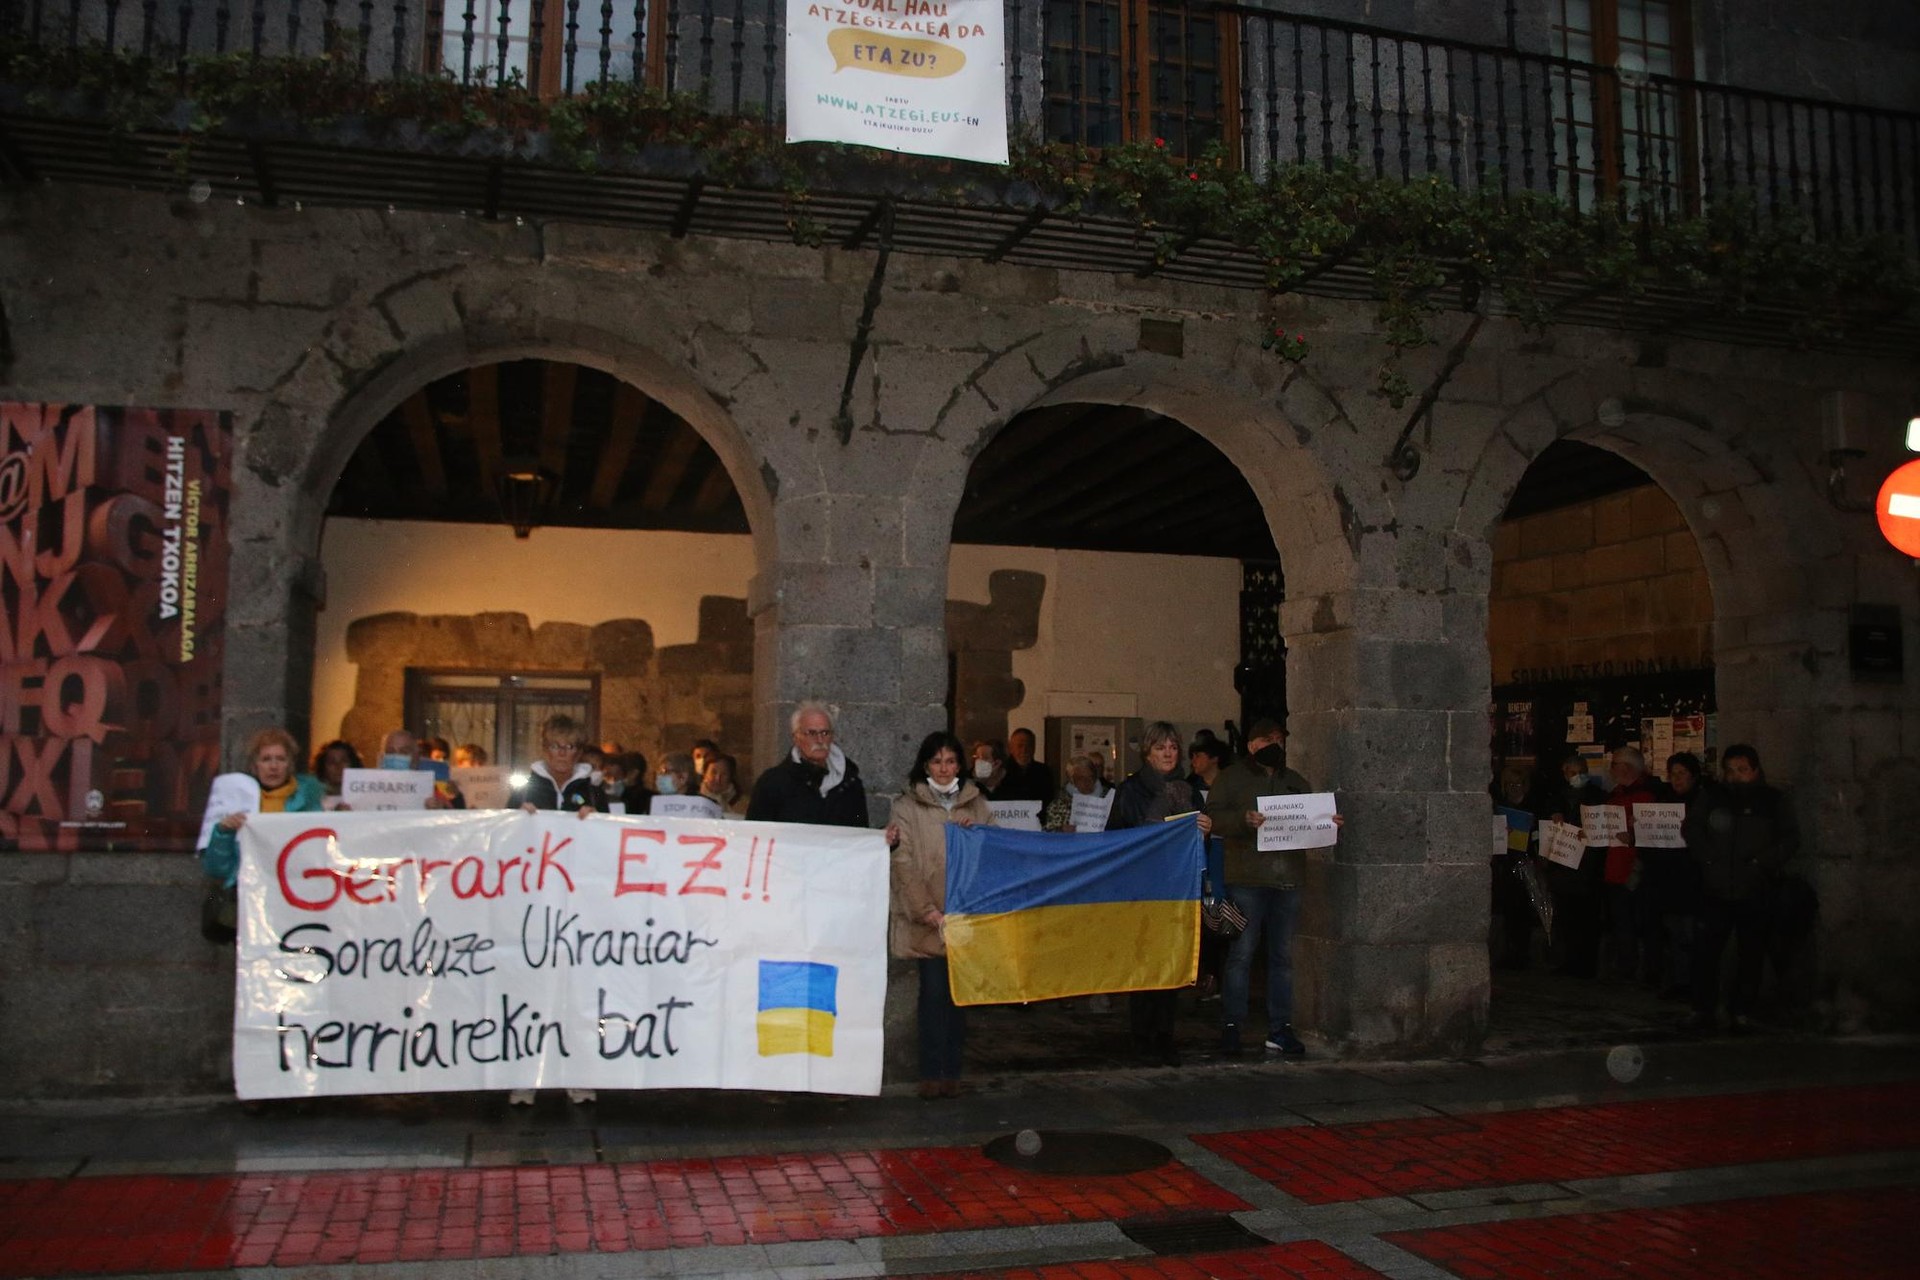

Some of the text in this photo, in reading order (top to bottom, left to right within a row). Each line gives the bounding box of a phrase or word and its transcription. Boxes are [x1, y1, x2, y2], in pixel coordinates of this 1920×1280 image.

[905, 0, 948, 17] HAU
[958, 23, 985, 39] DA
[854, 44, 937, 69] ETA ZU?
[159, 436, 185, 620] HITZEN TXOKOA
[349, 780, 417, 794] GERRARIK
[275, 827, 776, 911] Gerrarik EZ!!
[274, 917, 496, 983] Soraluze
[278, 988, 694, 1073] herriarekin bat
